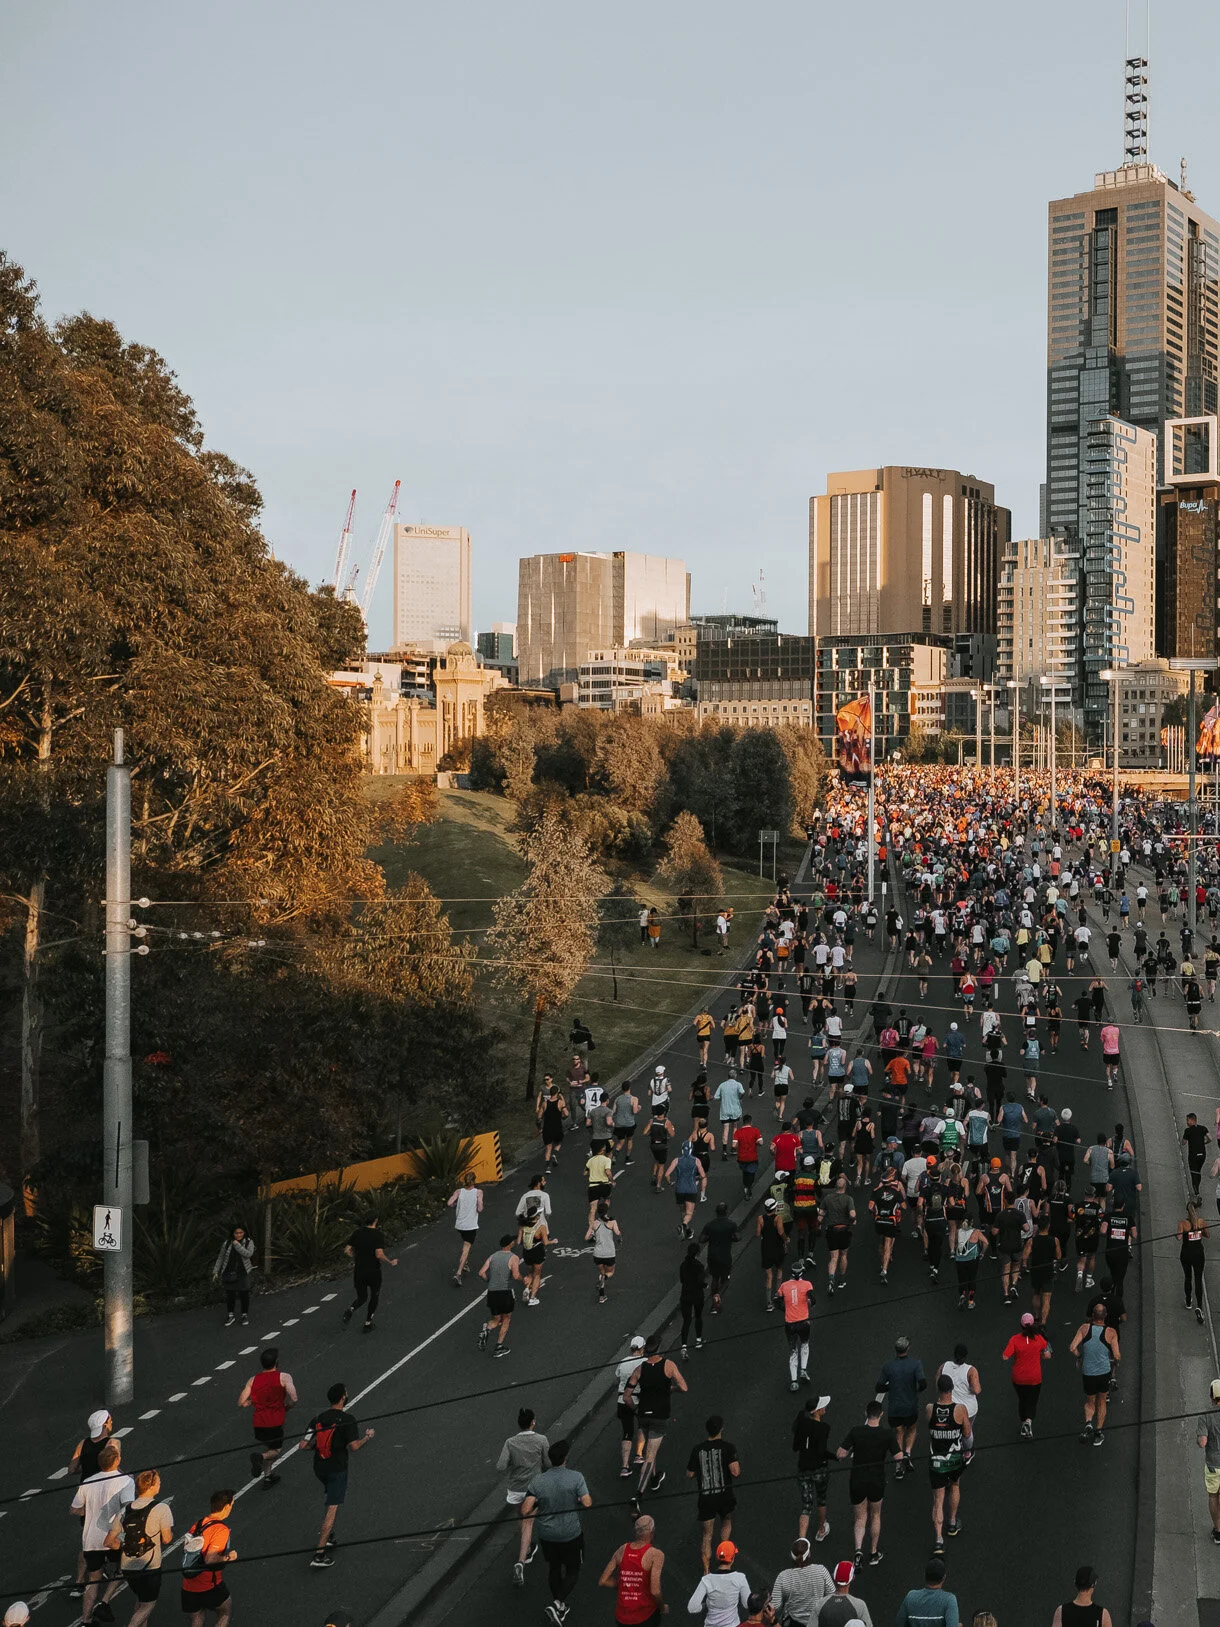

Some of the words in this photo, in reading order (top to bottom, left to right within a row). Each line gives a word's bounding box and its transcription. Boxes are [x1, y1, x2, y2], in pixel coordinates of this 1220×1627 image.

[905, 468, 942, 479] HYATT
[1180, 501, 1198, 509] Bupa
[414, 526, 450, 537] UniSuper
[591, 1091, 598, 1105] 4
